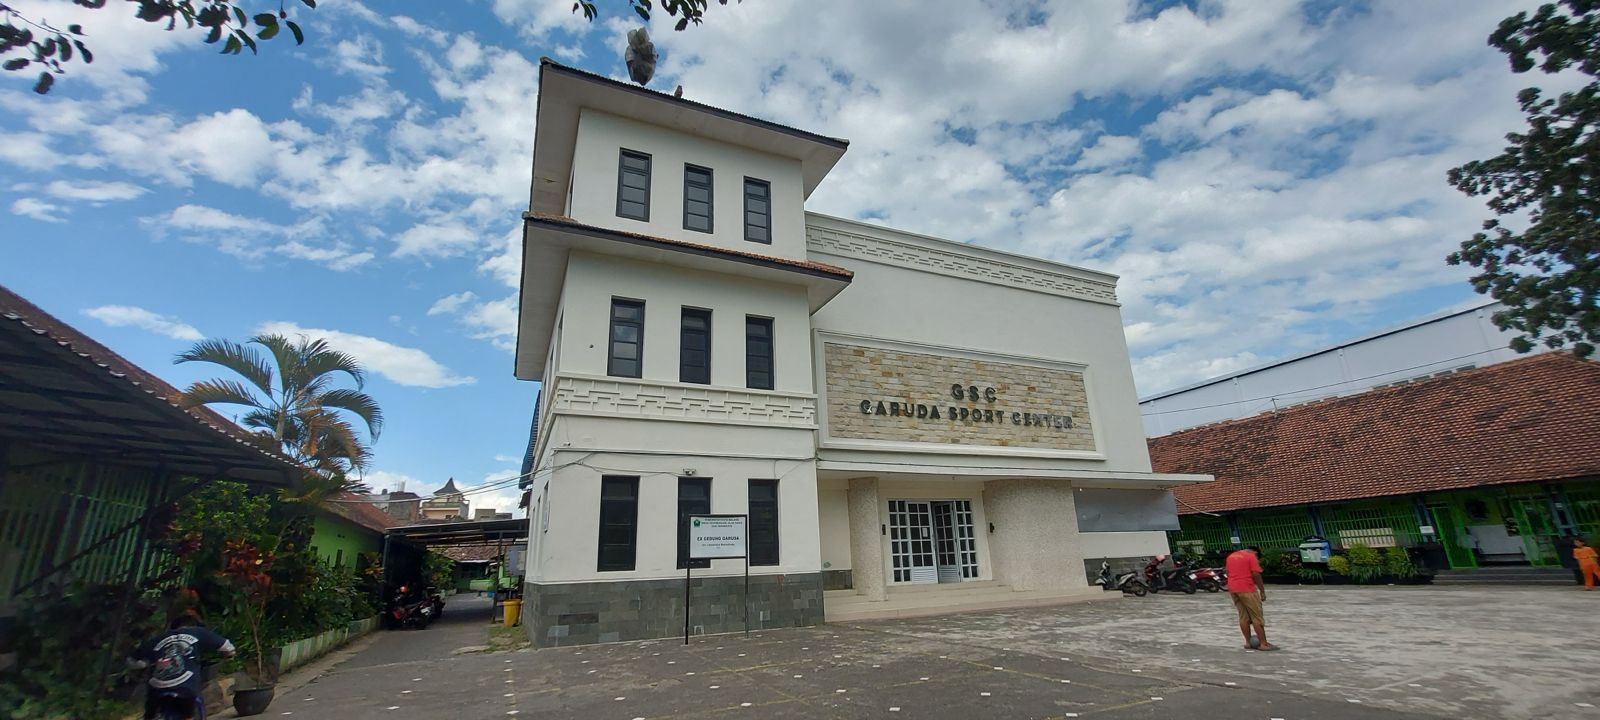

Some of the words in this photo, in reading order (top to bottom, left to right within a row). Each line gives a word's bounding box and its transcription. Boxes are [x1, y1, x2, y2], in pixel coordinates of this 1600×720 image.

[860, 399, 941, 420] GARUDA
[948, 406, 1004, 424] SPORT
[1010, 412, 1074, 429] CENTER
